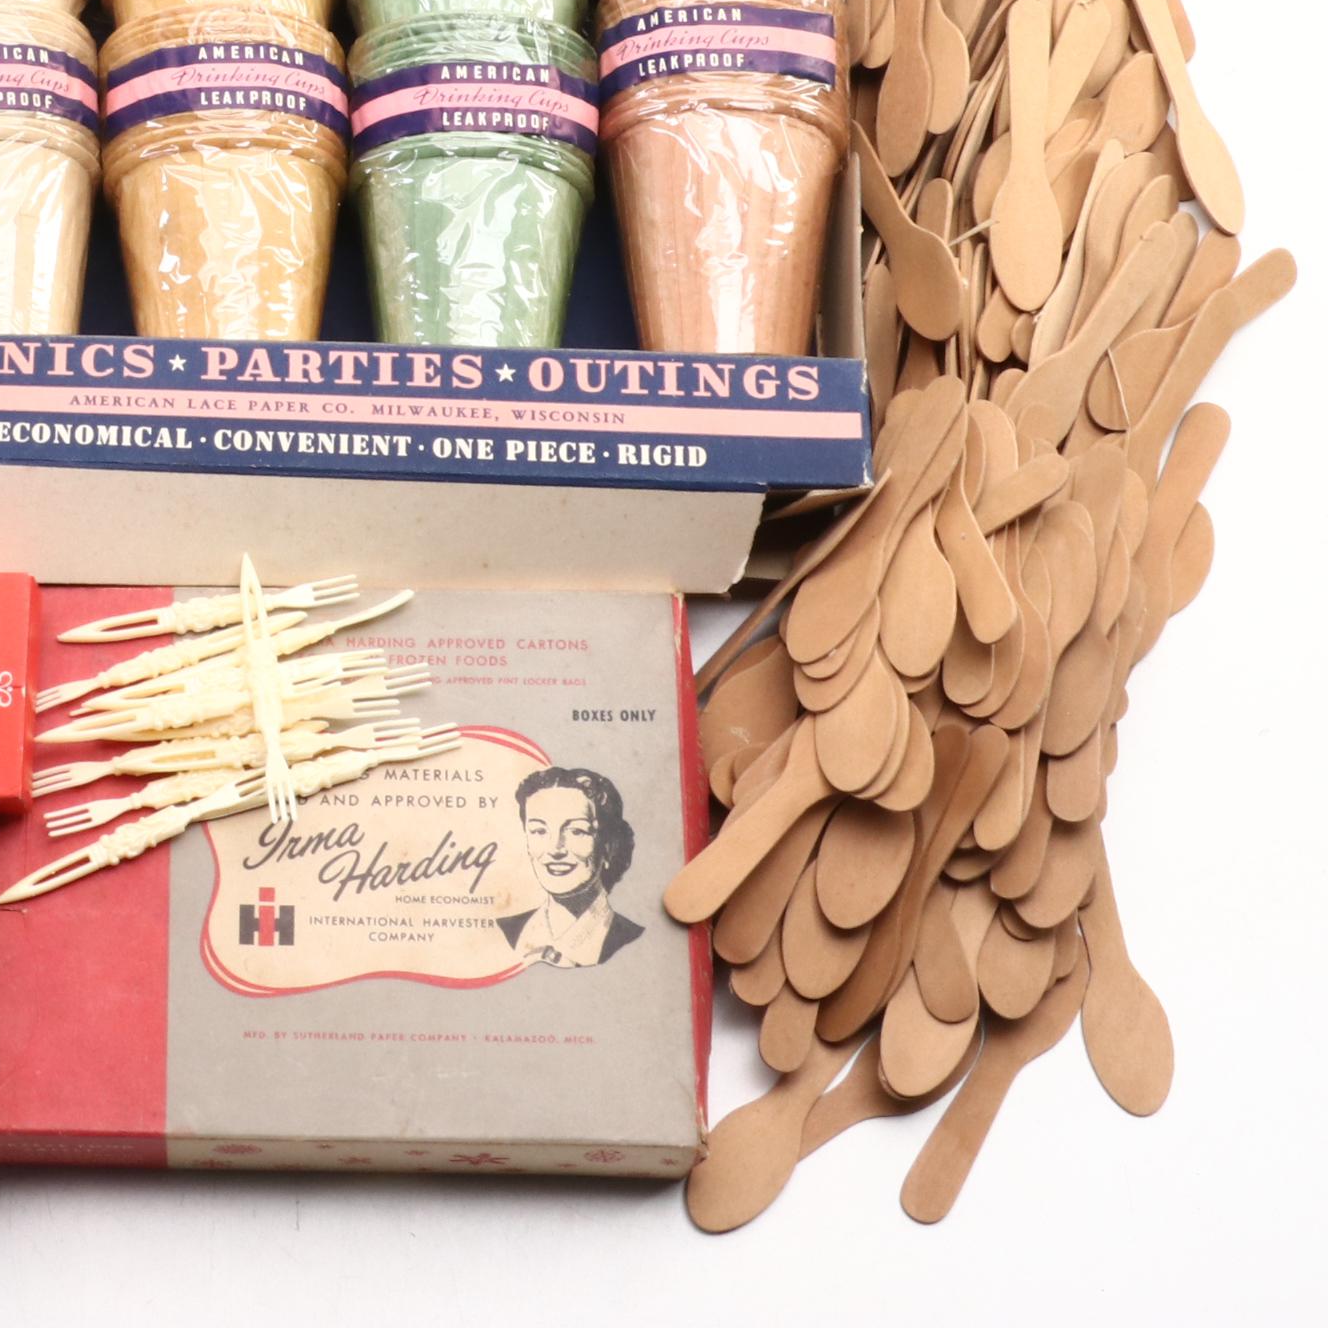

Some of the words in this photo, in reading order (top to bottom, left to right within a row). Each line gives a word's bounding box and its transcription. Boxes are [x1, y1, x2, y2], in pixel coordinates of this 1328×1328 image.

[200, 347, 483, 389] PARTIES
[528, 359, 820, 401] OUTINGS
[70, 394, 175, 408] AMERICAN
[187, 398, 237, 410] LACE
[248, 400, 310, 413] PAPER
[322, 402, 355, 416] CO.
[371, 404, 500, 422] MILWAUKEE,
[511, 409, 625, 424] WISCONSIN
[214, 428, 411, 458] CONVENIENT
[433, 437, 495, 460] ONE
[507, 440, 595, 464] PIECE
[617, 444, 707, 467] RIGID
[346, 637, 415, 649] HARDING
[427, 639, 506, 650] APPROVED
[517, 640, 589, 651] CARTONS
[388, 655, 447, 666] FROZEN
[456, 656, 507, 667] FOODS
[572, 710, 613, 721] BOXES
[620, 710, 656, 721] ONLY
[384, 770, 484, 782] MATERIALS
[321, 794, 359, 806] AND
[372, 795, 466, 808] APPROVED
[479, 797, 498, 808] BY
[243, 812, 364, 870] Irma
[319, 831, 498, 902] Harding
[396, 896, 426, 904] HOME
[431, 896, 494, 905] ECONOMIST
[309, 916, 414, 928] INTERNATIONAL
[423, 918, 494, 929] HARVESTER
[369, 932, 434, 942] COMPANY
